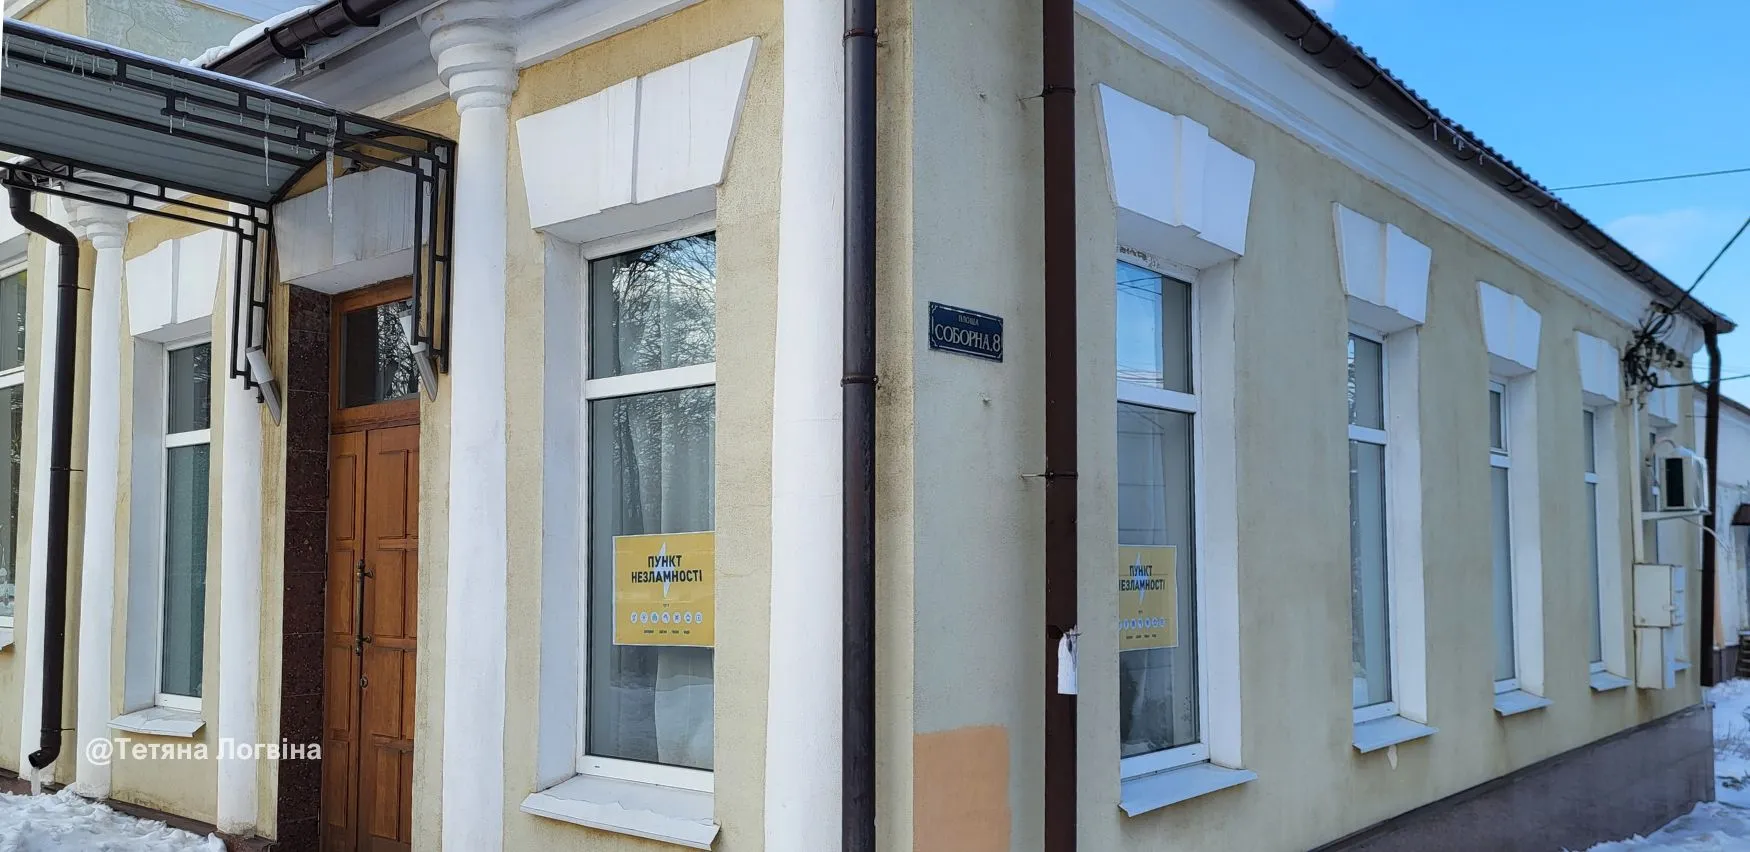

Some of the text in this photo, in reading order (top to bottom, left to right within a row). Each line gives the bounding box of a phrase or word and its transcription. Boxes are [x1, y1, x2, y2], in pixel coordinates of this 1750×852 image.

[648, 555, 682, 568] ПУНКТ
[631, 570, 702, 583] НЕЗЛАМНОСТІ
[1129, 565, 1152, 577] ПУНКТ
